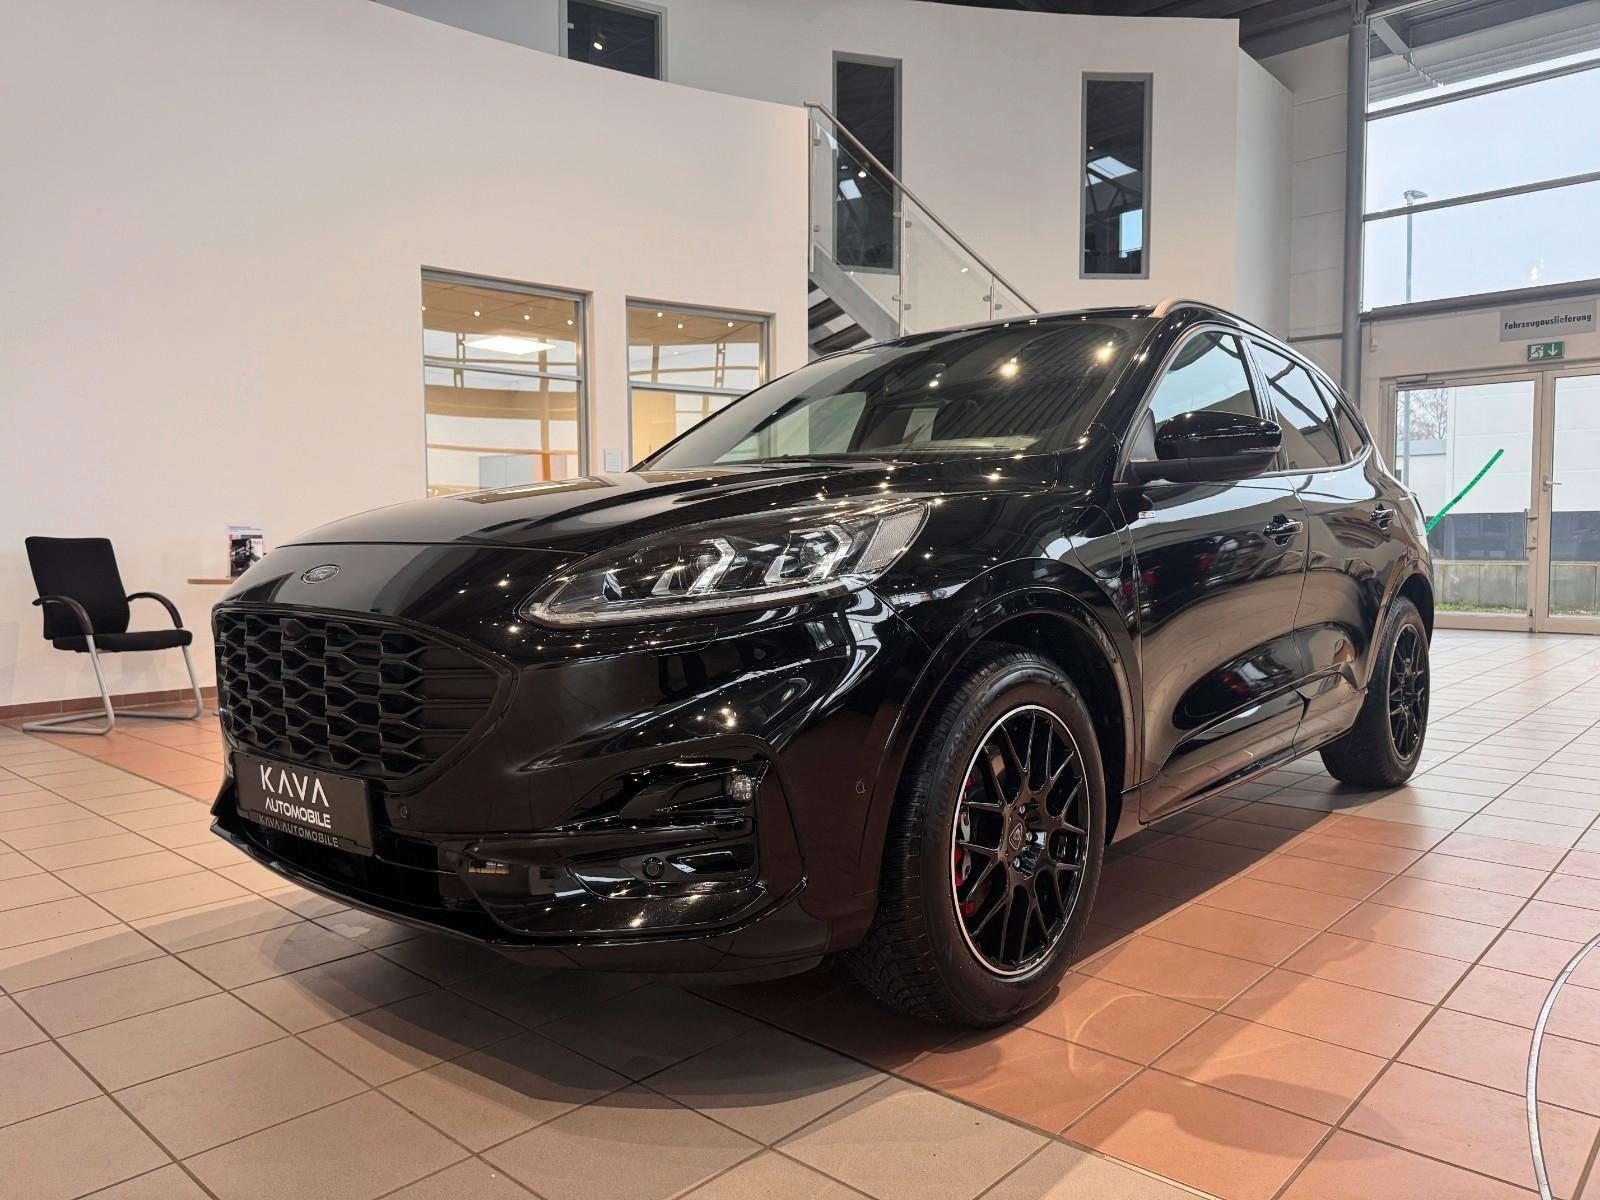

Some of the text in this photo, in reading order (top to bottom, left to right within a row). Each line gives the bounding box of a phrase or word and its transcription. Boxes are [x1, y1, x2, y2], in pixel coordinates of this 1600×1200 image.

[1504, 314, 1592, 331] Fahrzeugauslieferung
[260, 764, 330, 808] KAVA
[265, 797, 332, 829] AUTOMOBILE
[259, 815, 340, 848] KAVA AUTOMOBILE
